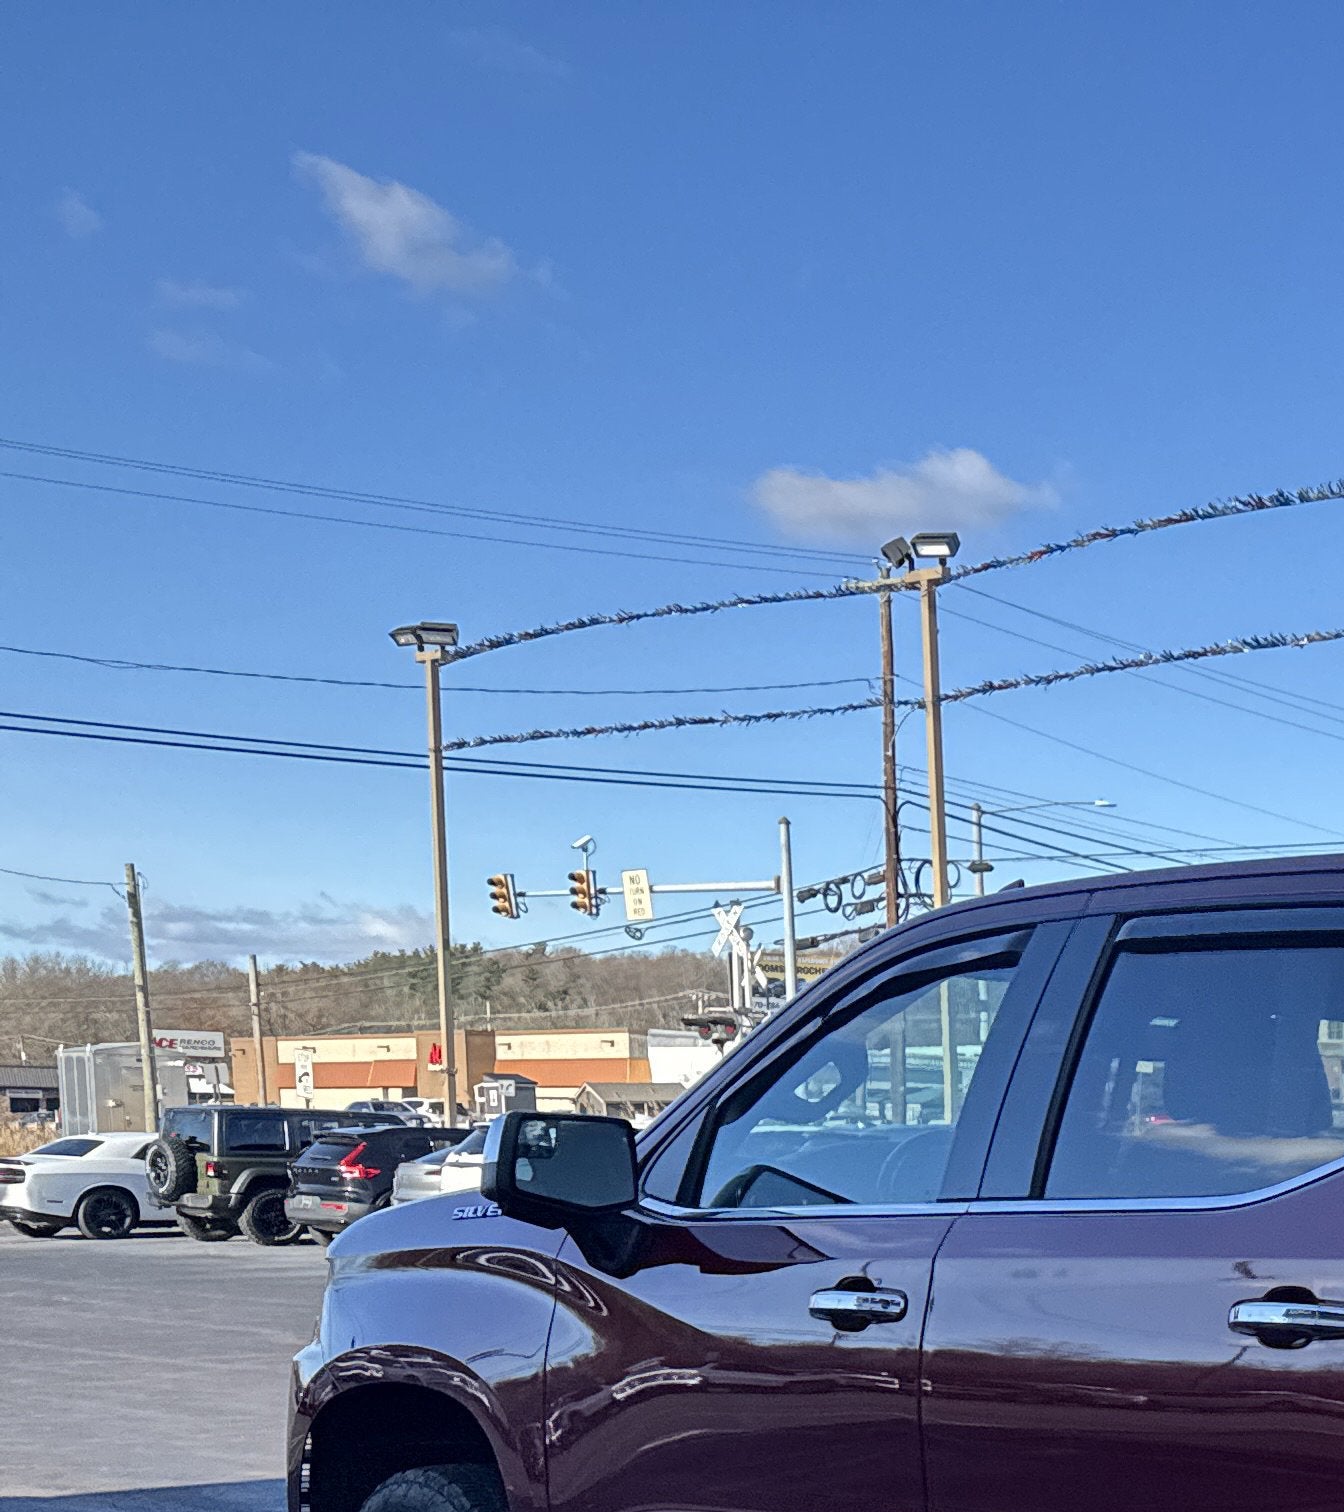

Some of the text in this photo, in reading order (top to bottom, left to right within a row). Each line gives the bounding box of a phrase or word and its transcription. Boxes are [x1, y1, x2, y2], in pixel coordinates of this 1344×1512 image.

[629, 874, 641, 885] NO
[630, 887, 645, 895] TURN
[633, 907, 646, 916] RED
[152, 1037, 178, 1049] ACE
[452, 1203, 502, 1220] SILVE
